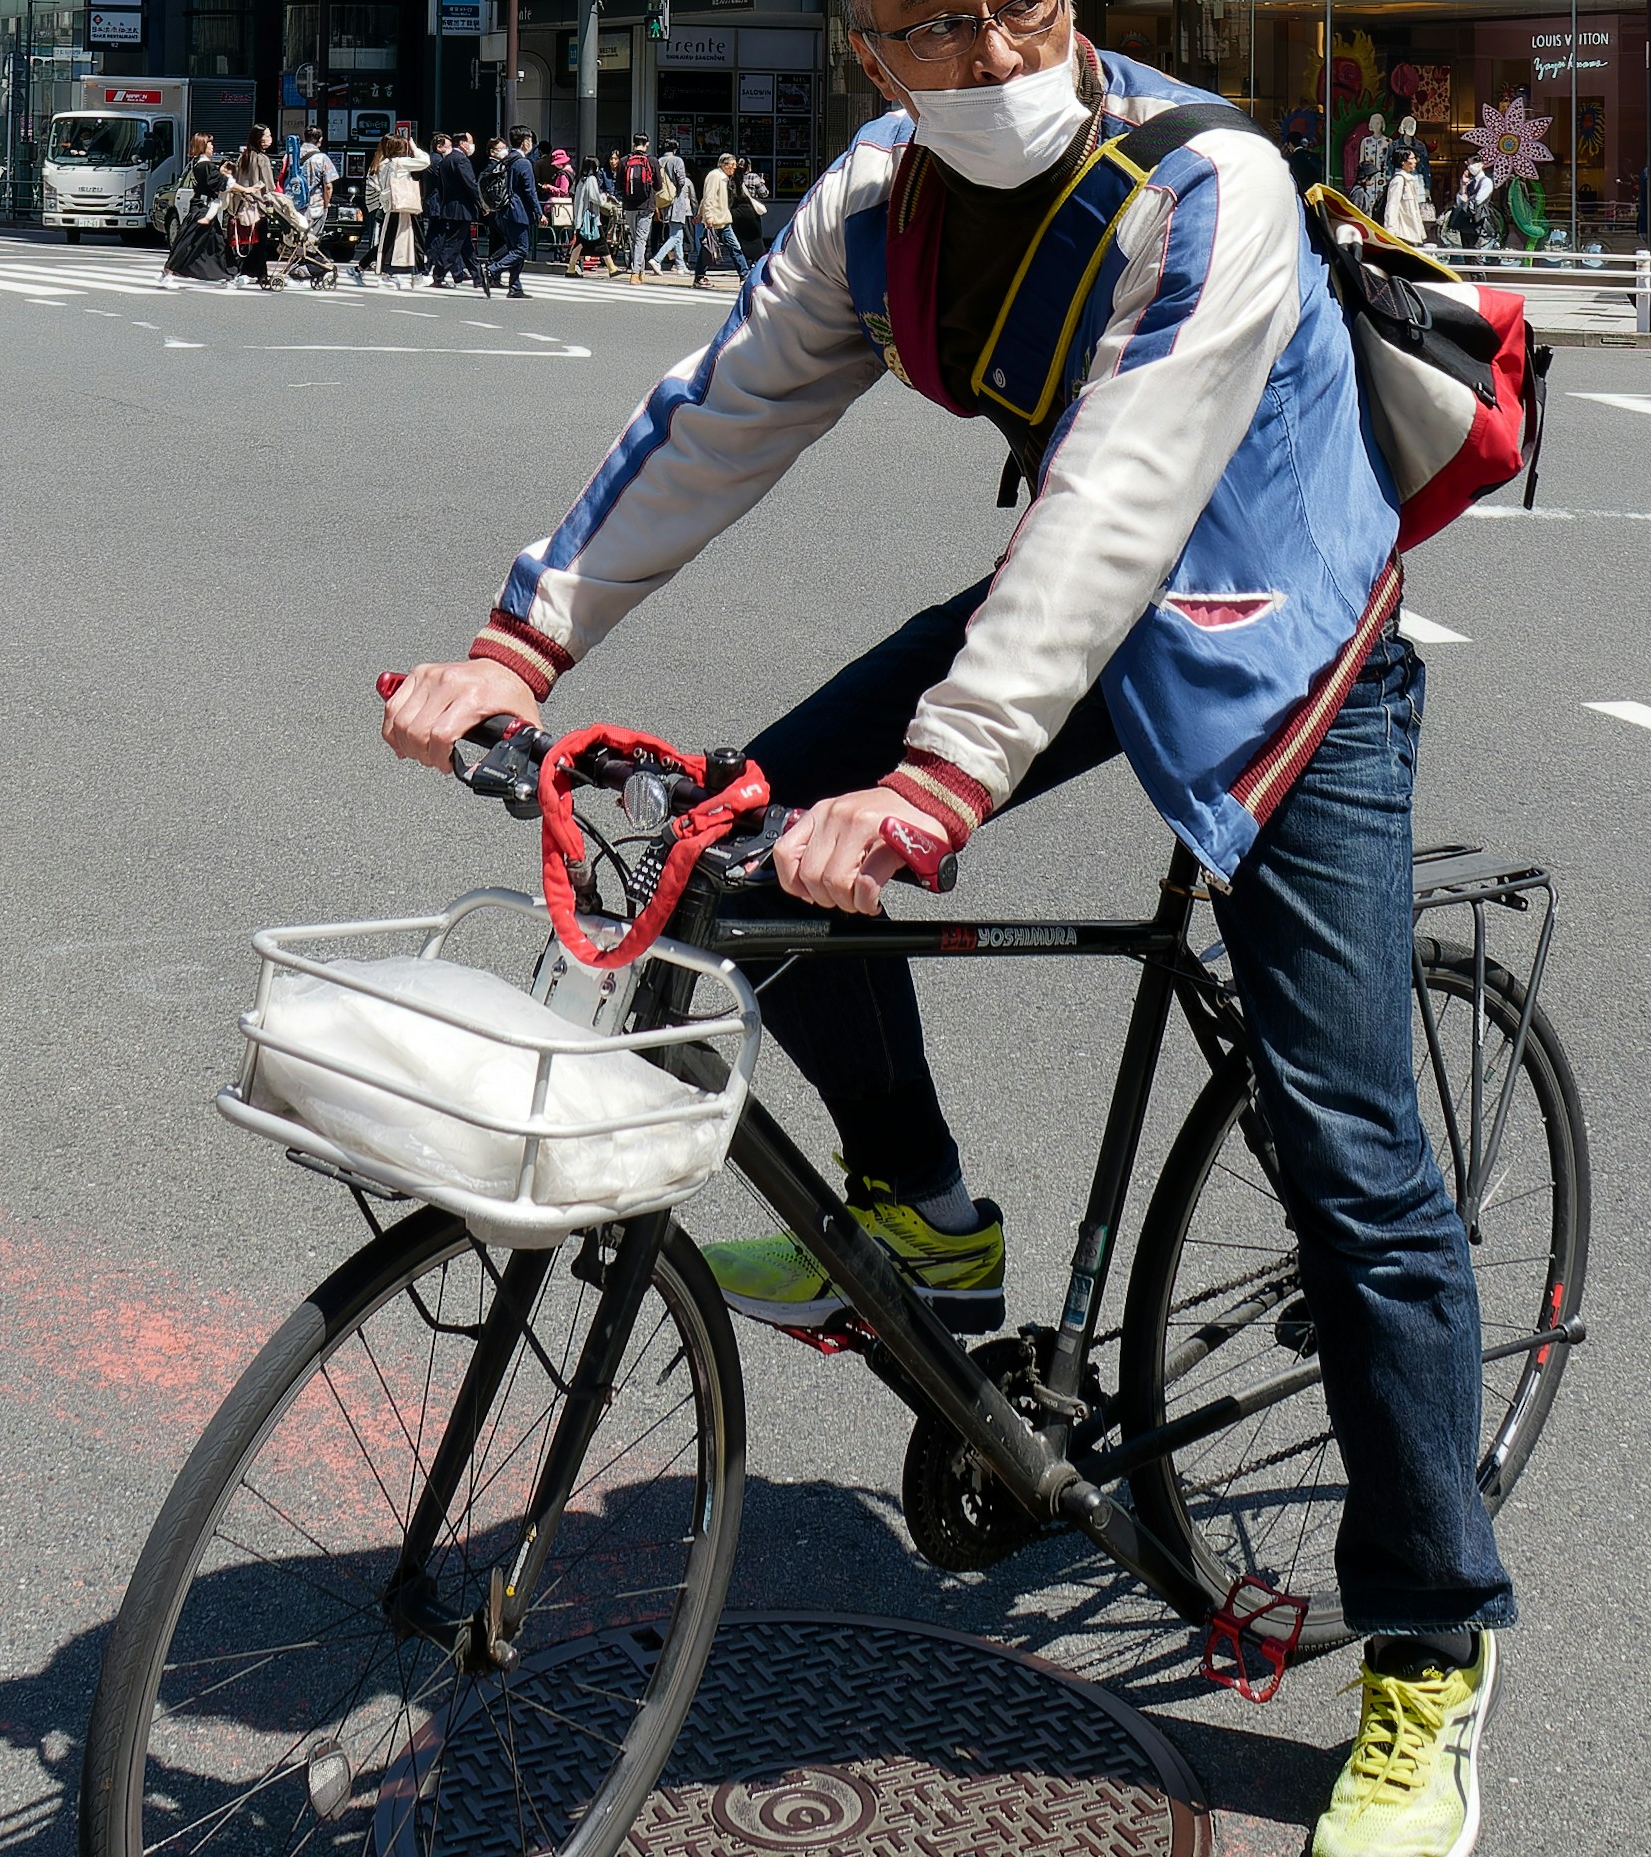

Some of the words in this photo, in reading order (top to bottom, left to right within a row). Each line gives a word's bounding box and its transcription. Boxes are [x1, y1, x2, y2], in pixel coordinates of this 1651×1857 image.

[1531, 34, 1562, 49] LOUIS
[1565, 32, 1610, 47] VITTON
[976, 927, 1078, 948] YOSHIMURA
